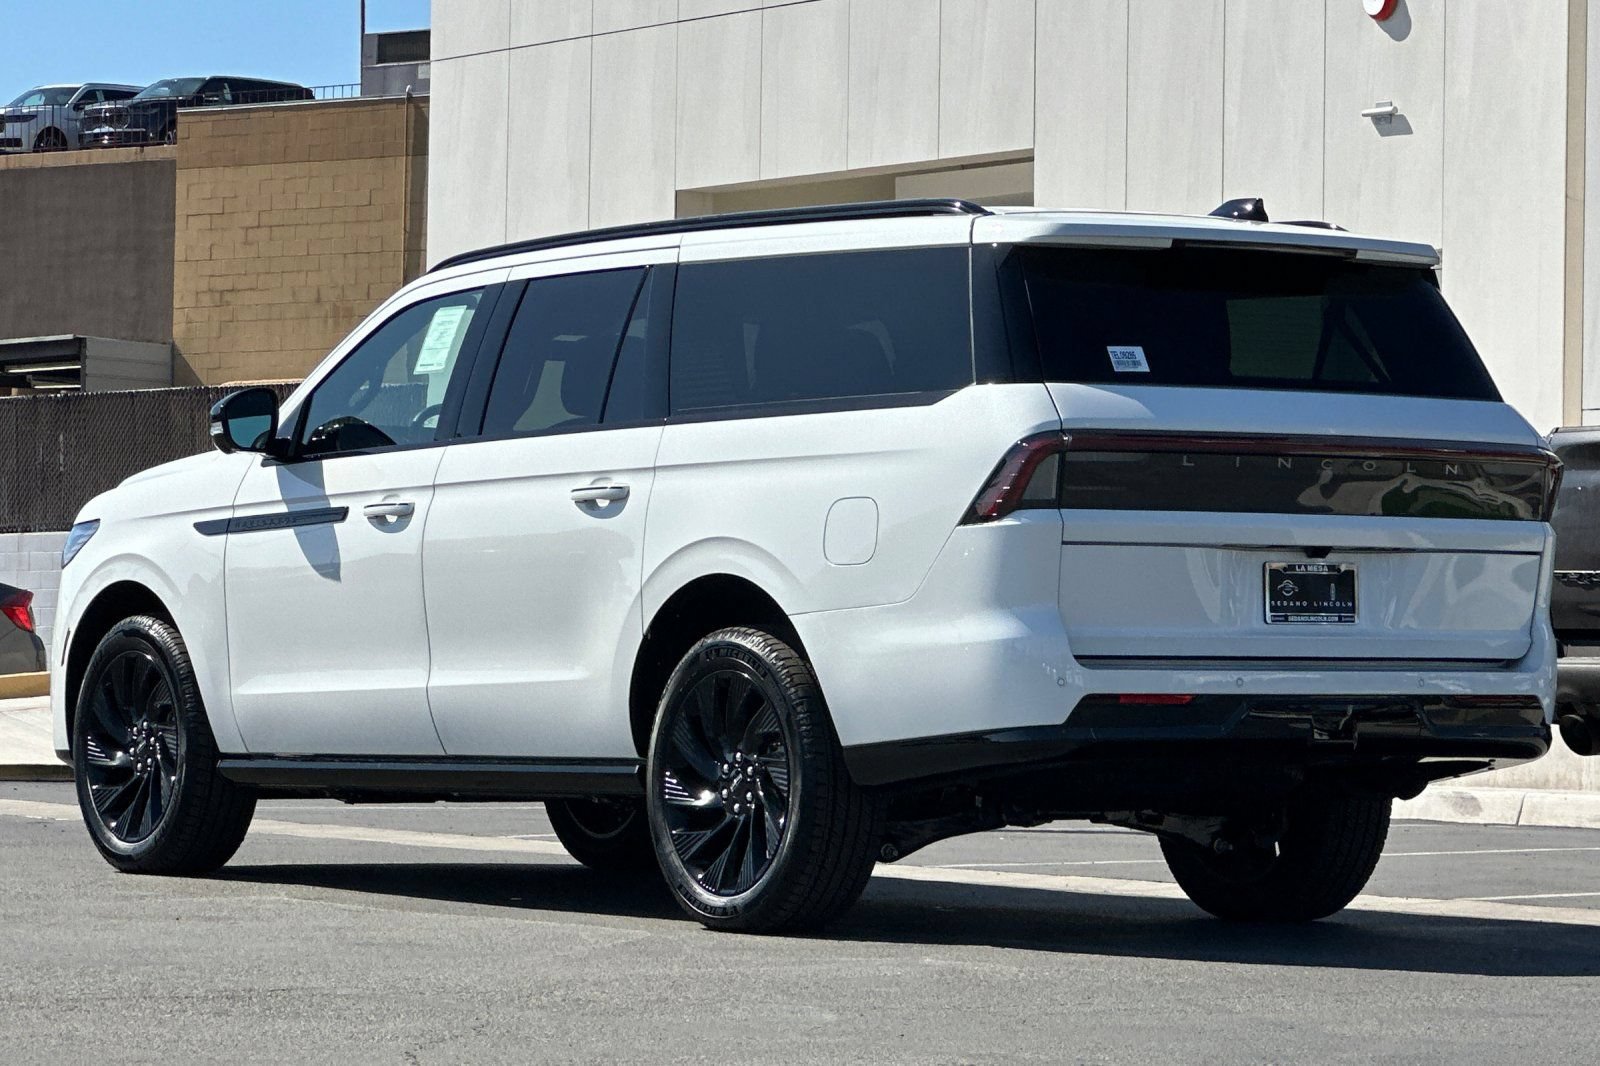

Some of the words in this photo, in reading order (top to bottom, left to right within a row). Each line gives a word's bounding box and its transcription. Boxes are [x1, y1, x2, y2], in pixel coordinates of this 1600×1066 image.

[1182, 455, 1458, 476] LINCOLN
[1295, 564, 1306, 572] LA
[1307, 564, 1329, 572] MESA
[719, 647, 768, 678] MICHELIN
